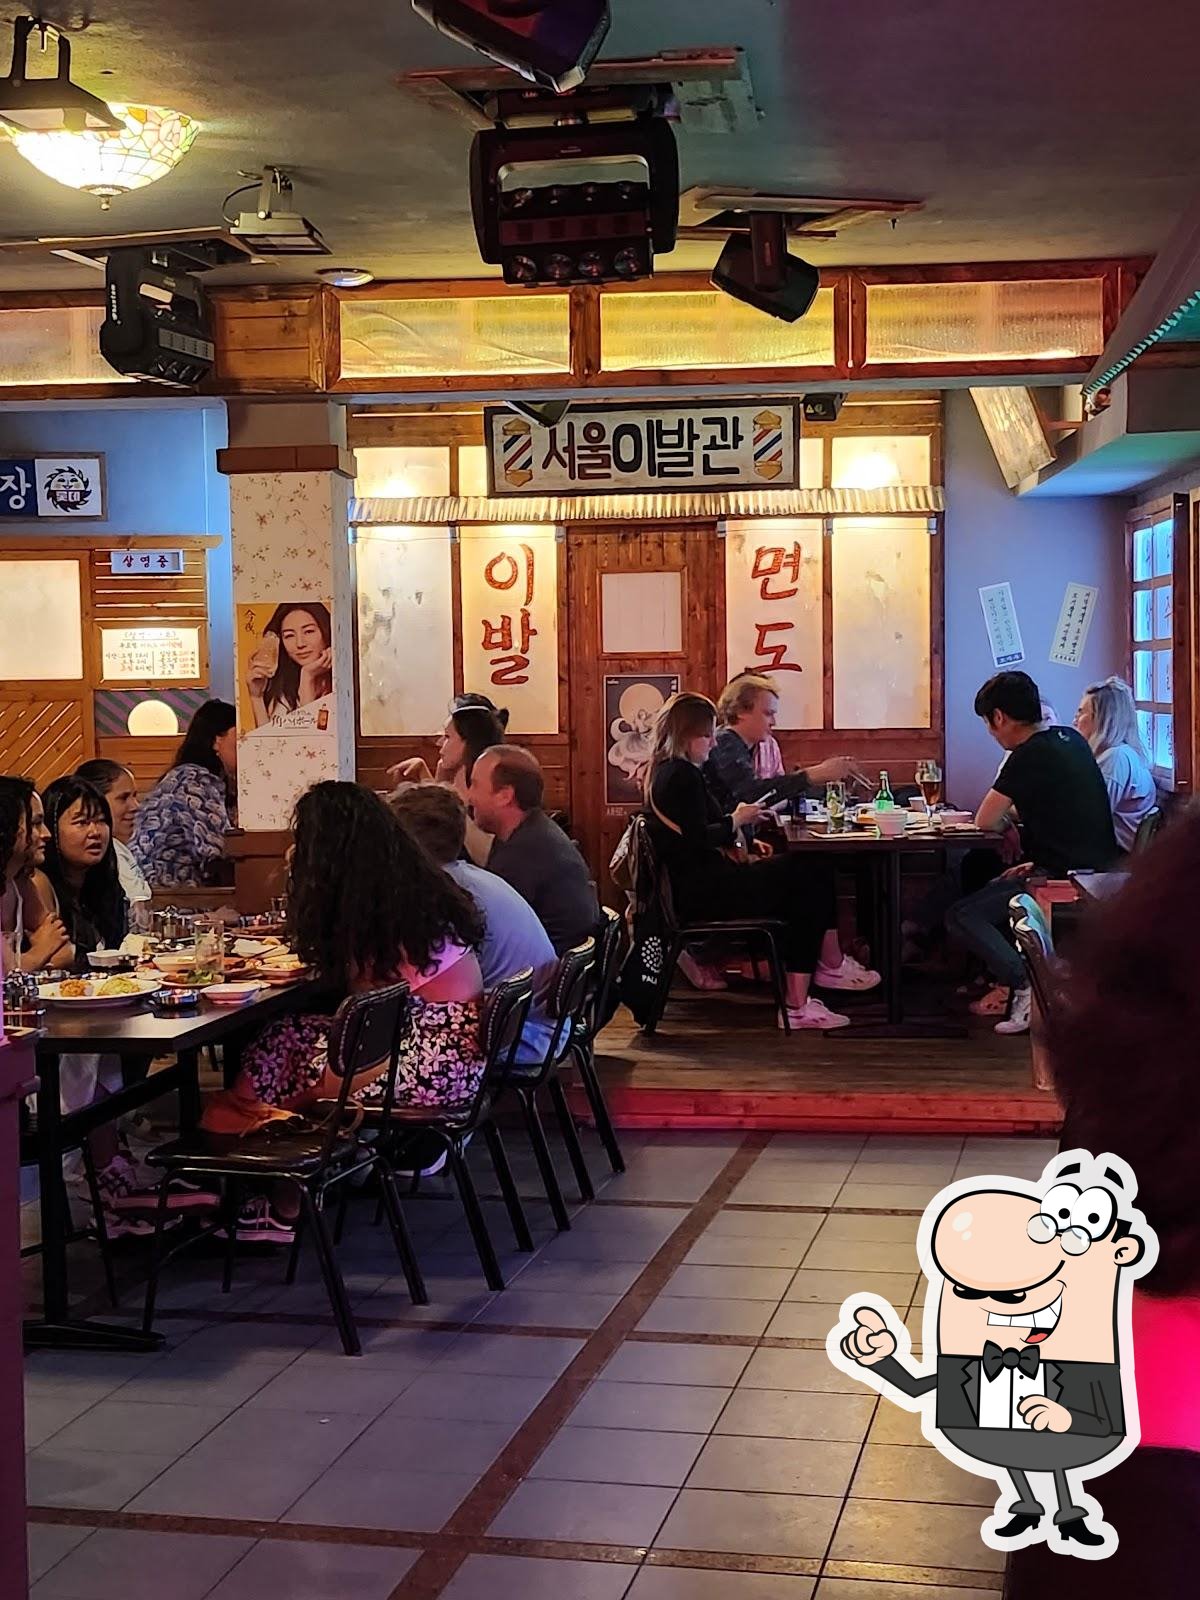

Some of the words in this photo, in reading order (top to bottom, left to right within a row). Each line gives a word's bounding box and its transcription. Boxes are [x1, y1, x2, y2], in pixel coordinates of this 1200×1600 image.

[541, 415, 745, 481] 서울이발관
[0, 465, 32, 510] 장
[122, 554, 169, 569] 상영중
[481, 543, 538, 686] 이발
[750, 540, 803, 674] 면도
